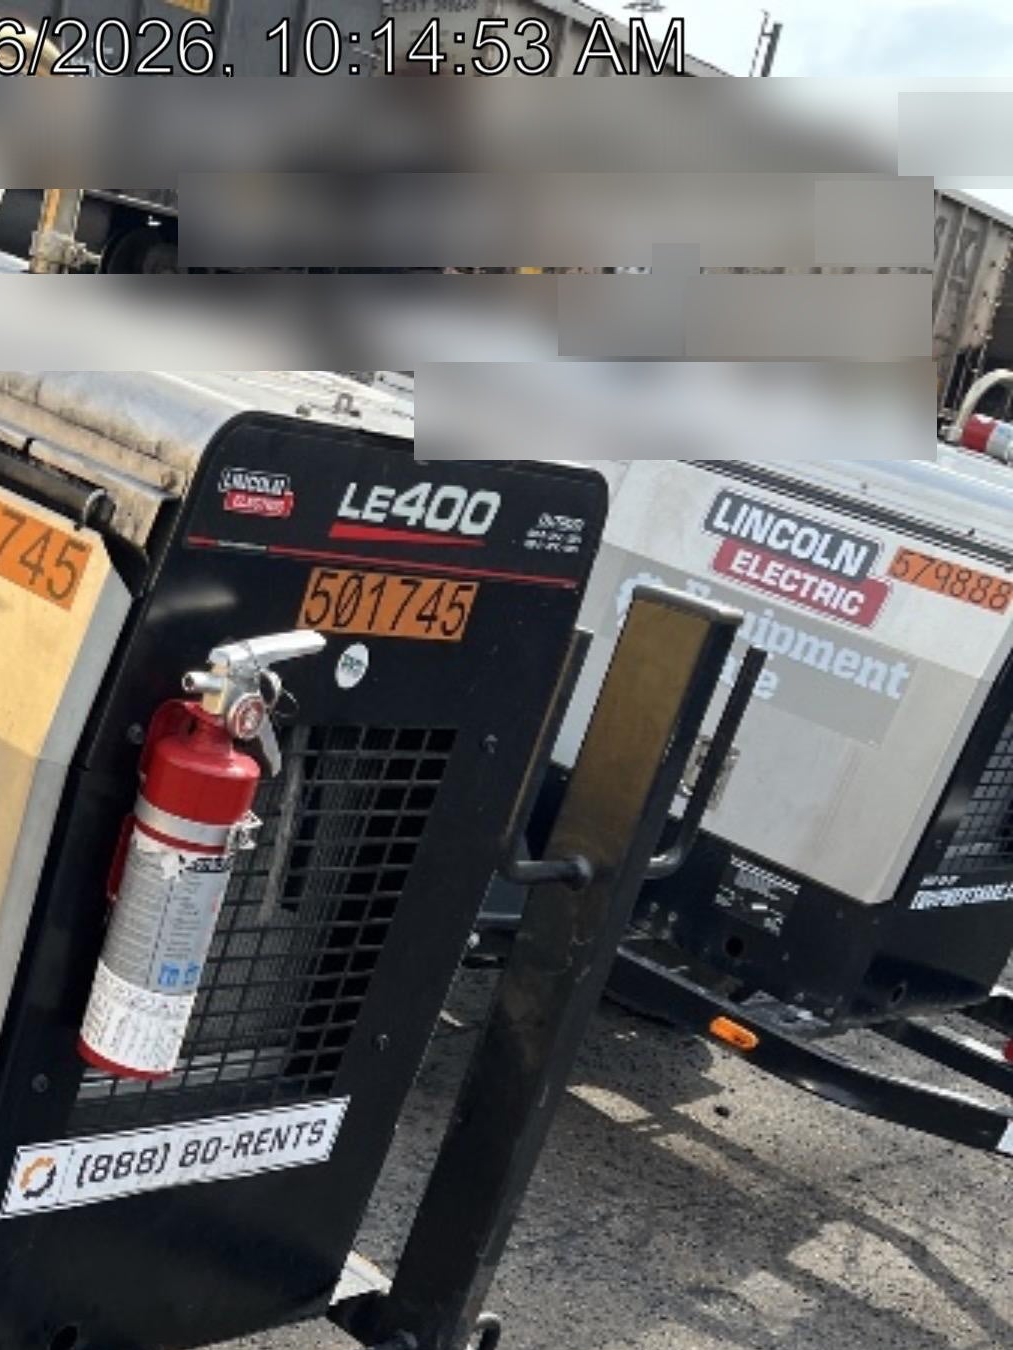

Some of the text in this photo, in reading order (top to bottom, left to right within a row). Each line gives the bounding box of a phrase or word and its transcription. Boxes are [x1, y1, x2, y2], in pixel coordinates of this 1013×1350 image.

[336, 481, 502, 537] LE400
[713, 497, 869, 579] LINCOLN
[304, 570, 474, 638] 501745
[730, 551, 865, 617] ELECTRIC
[892, 548, 1012, 612] 579888
[77, 1118, 328, 1189] (888) 80-RENTS
